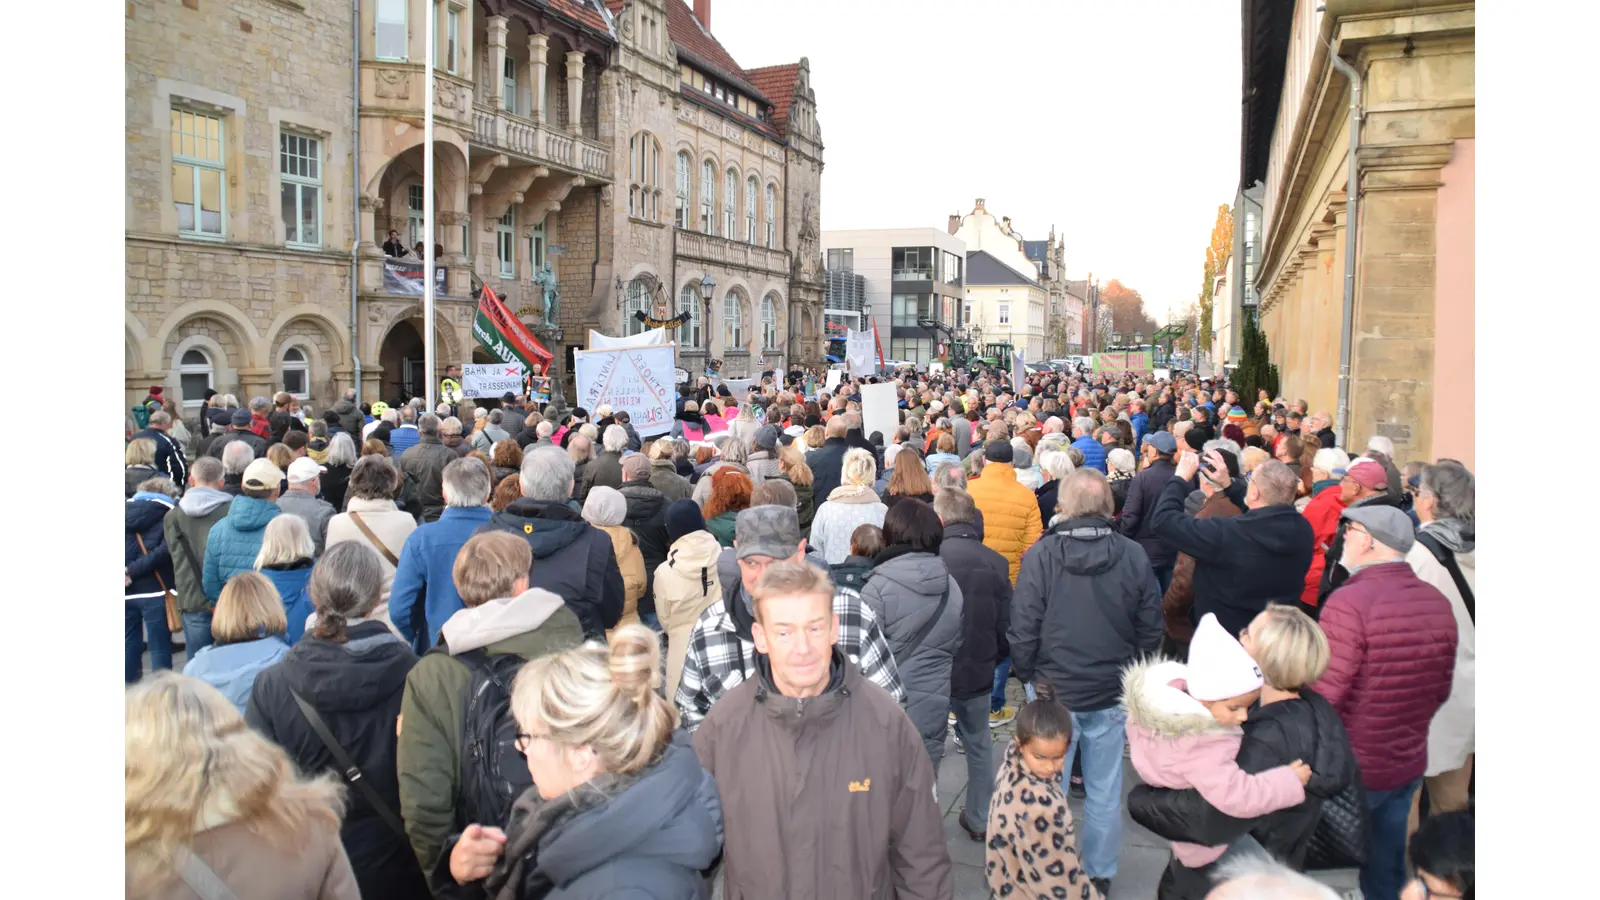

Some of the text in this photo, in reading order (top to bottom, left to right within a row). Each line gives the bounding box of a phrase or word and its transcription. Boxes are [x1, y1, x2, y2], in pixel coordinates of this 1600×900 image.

[464, 367, 501, 376] BAHN JA
[478, 380, 521, 391] TRASSENNAH
